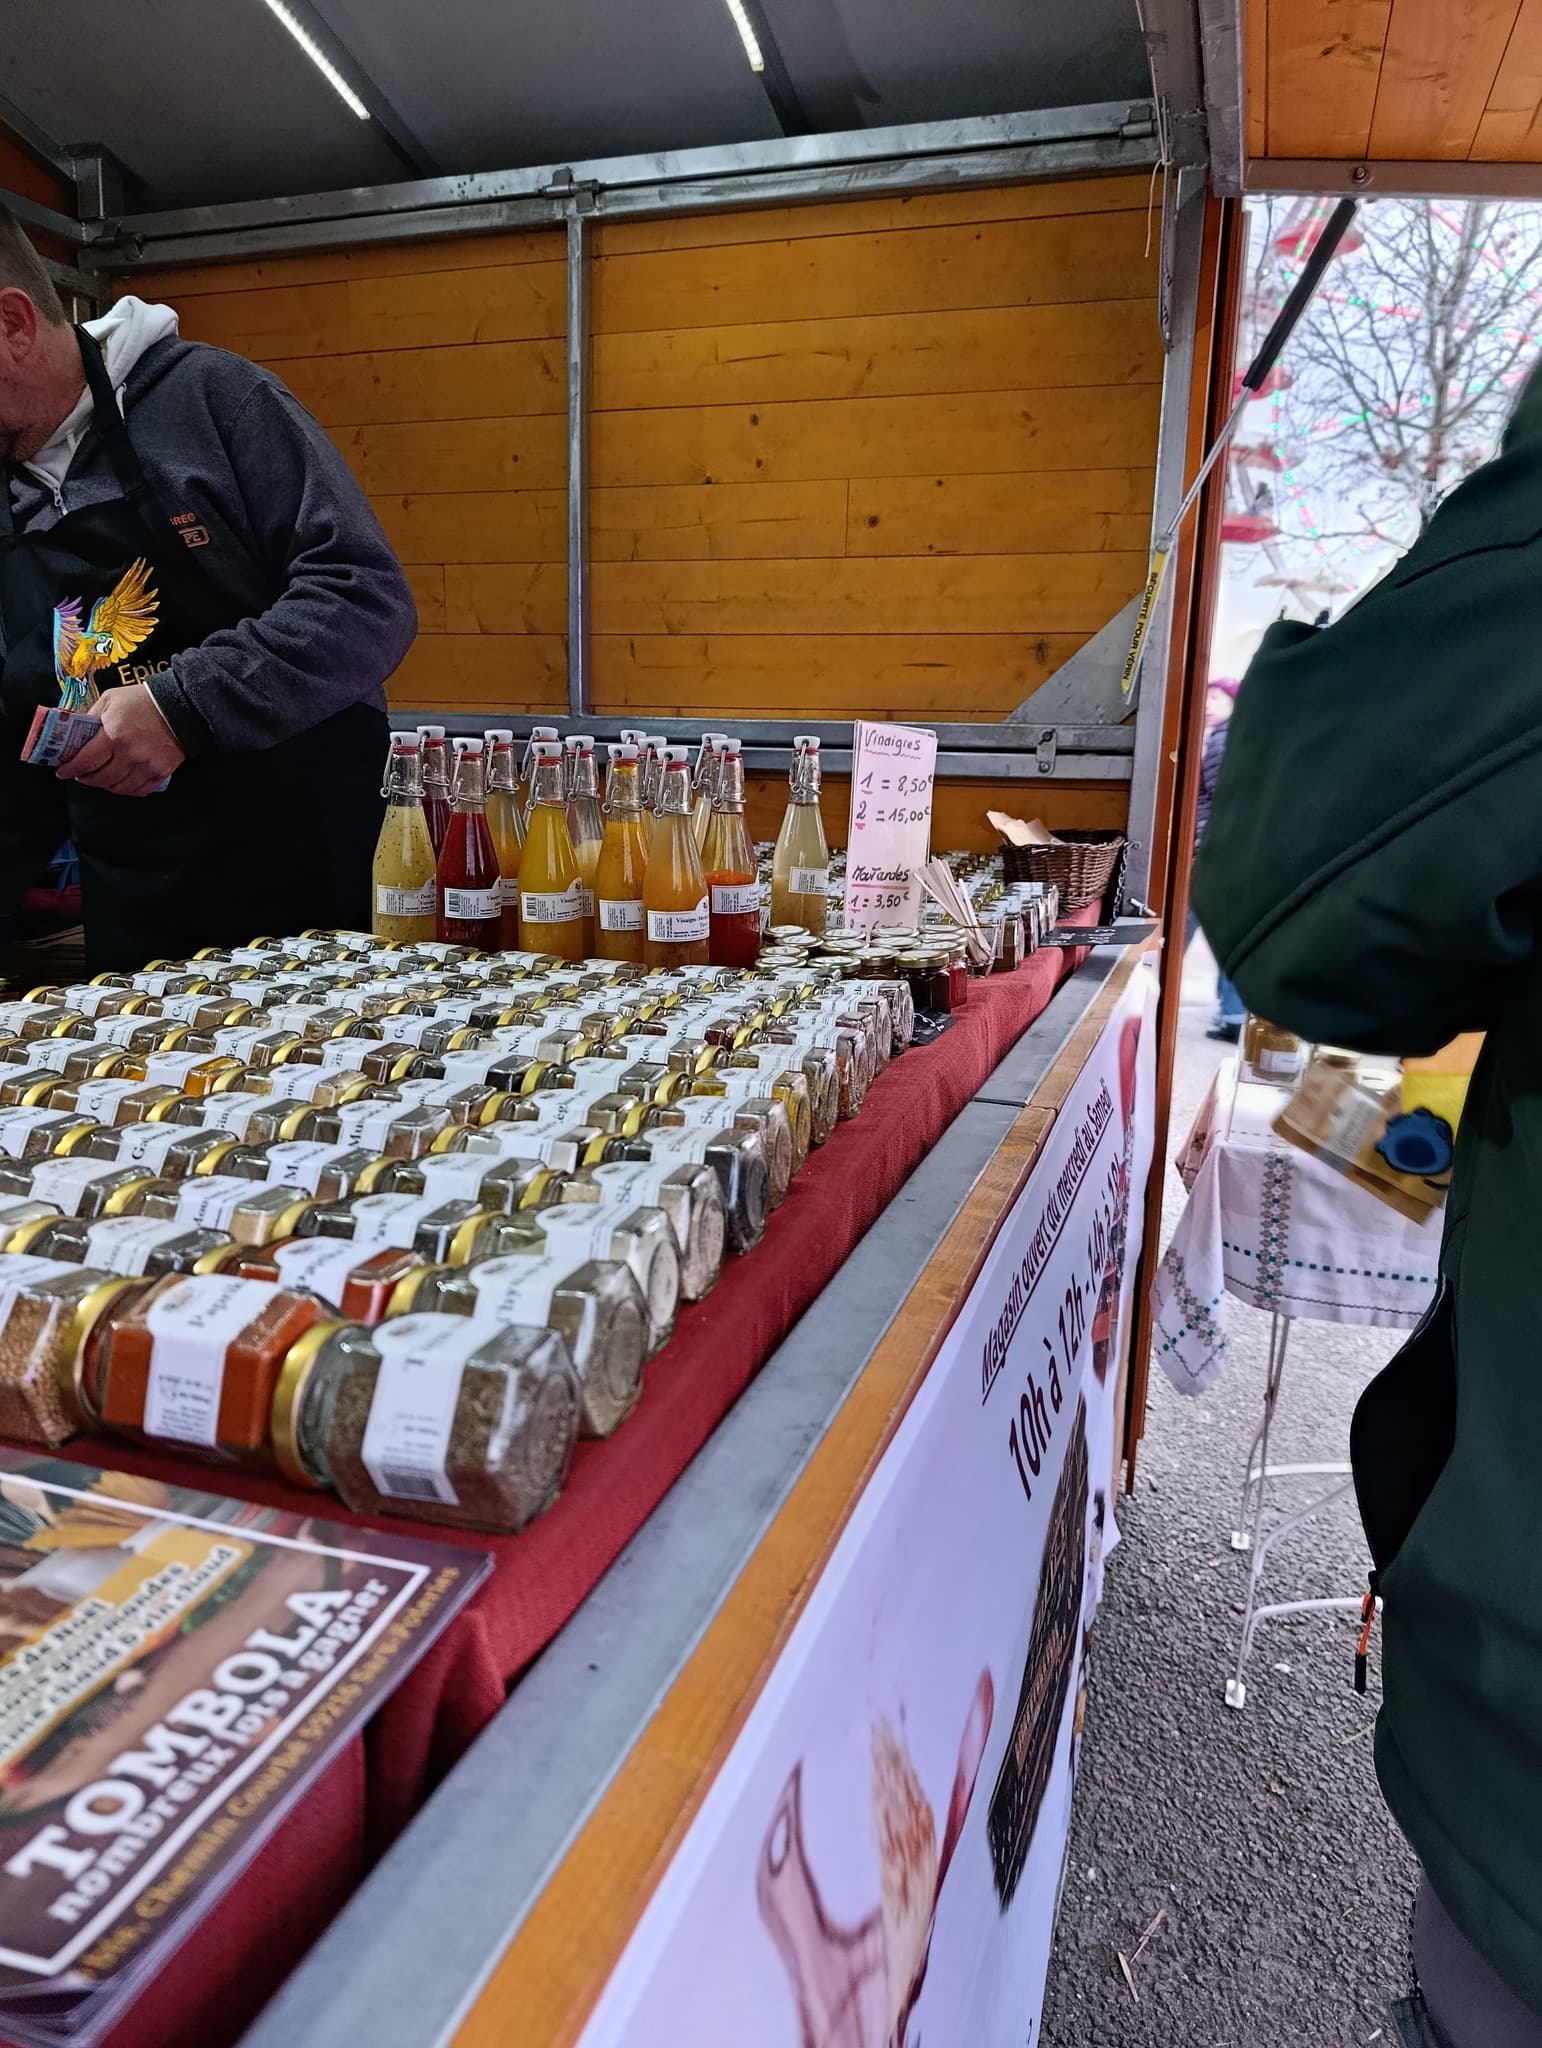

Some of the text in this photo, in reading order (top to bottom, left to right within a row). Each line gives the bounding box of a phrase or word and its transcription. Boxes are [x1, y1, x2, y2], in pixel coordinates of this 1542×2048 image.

[1130, 621, 1144, 650] POUR
[856, 800, 867, 820] 2
[860, 771, 873, 789] 1
[874, 890, 910, 909] 3,50€
[982, 1077, 1113, 1395] Magasin ouvert du mercredi au Samedi
[1009, 1372, 1052, 1502] 10h
[1043, 1336, 1063, 1414] à
[1059, 1272, 1085, 1375] 12h
[1088, 1208, 1106, 1295] 14h
[4, 1588, 353, 1880] TOMBOLA
[47, 1740, 237, 1924] nombreux
[222, 1686, 291, 1747] lots
[298, 1578, 389, 1673] gagner
